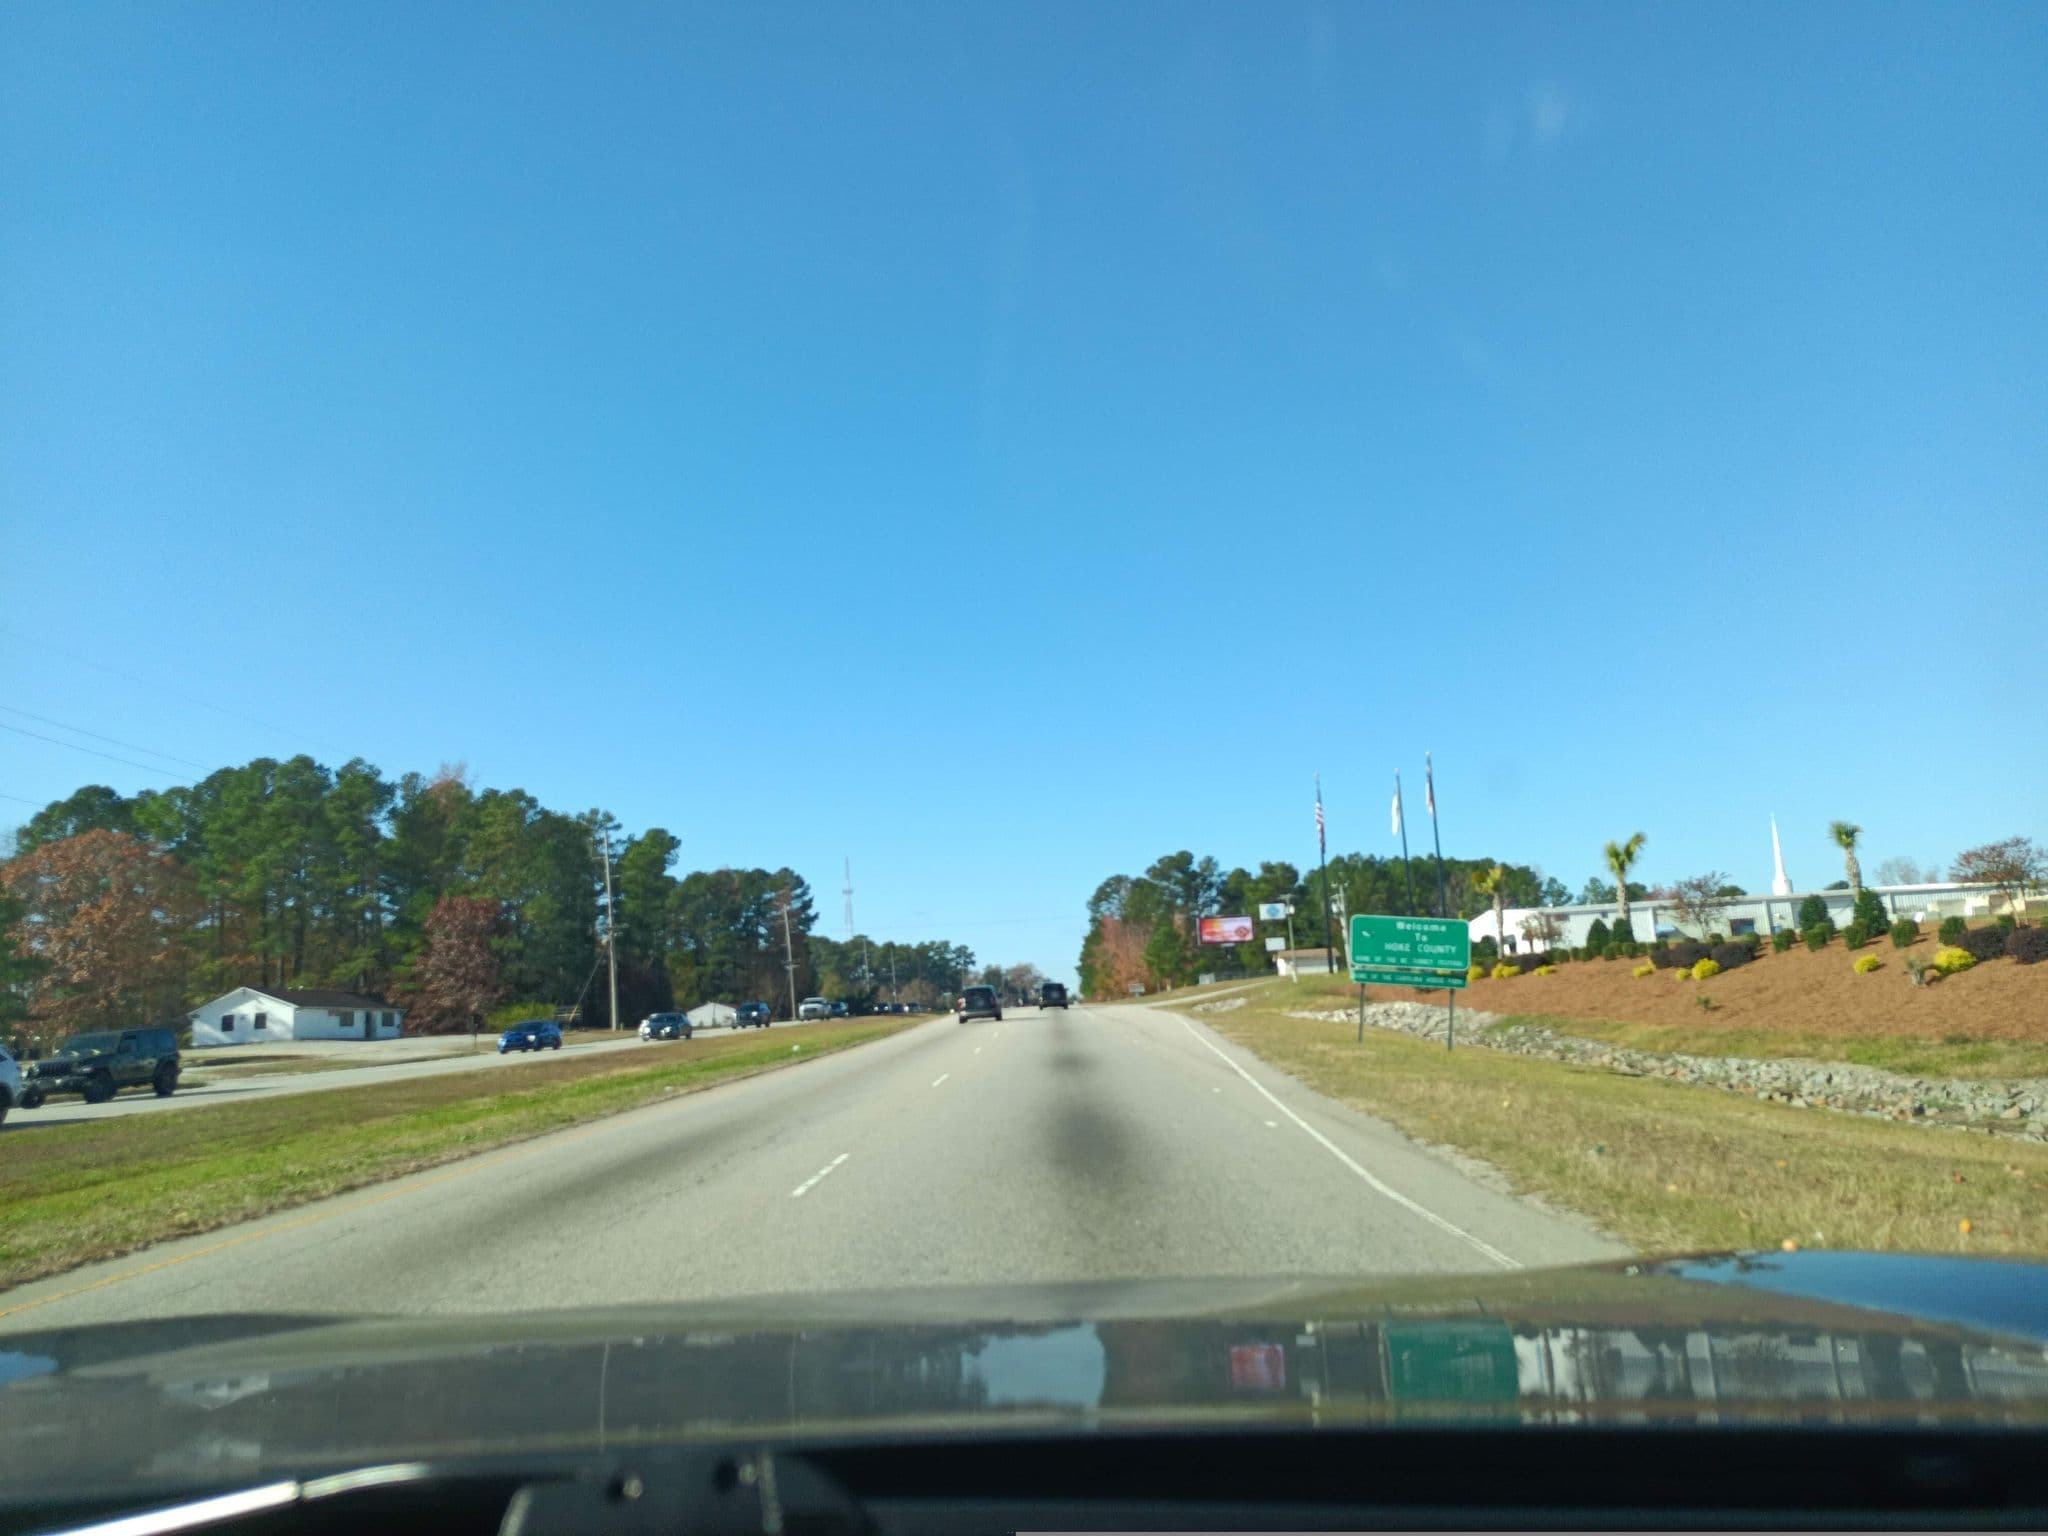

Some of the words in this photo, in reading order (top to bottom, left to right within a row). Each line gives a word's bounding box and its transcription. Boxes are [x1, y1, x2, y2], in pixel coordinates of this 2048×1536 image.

[1396, 921, 1447, 932] Welcome
[1415, 933, 1428, 942] To
[1417, 944, 1457, 954] COUNTY
